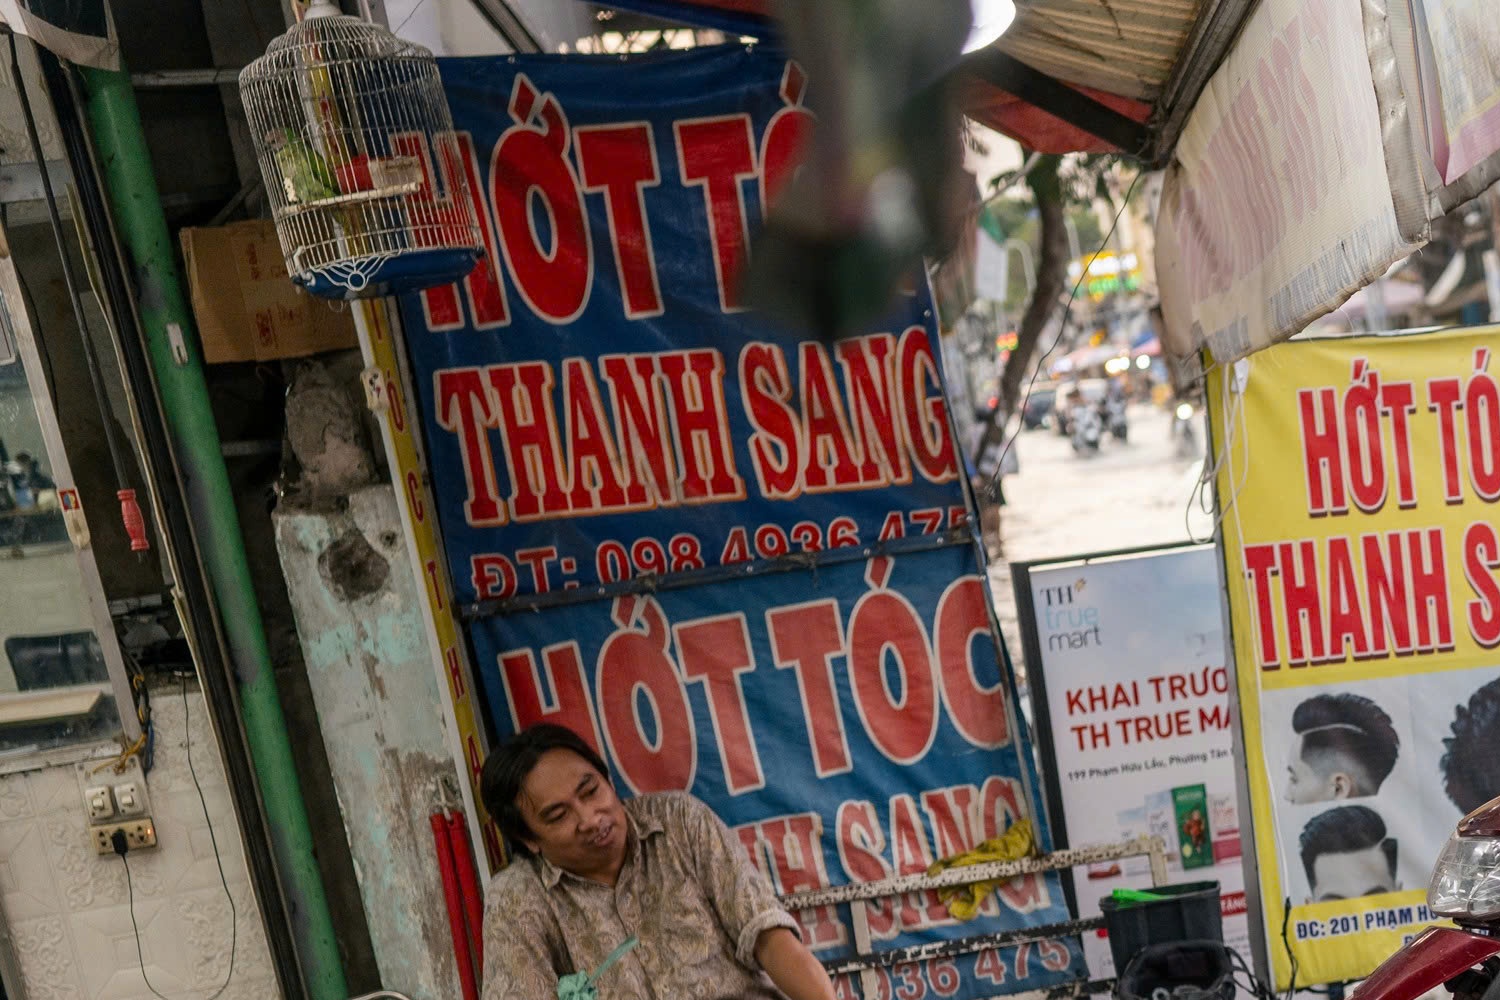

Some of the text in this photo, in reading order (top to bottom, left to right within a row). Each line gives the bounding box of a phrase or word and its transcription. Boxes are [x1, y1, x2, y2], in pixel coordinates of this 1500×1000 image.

[432, 325, 960, 527] THANH SANG
[1297, 355, 1418, 518] HỚT
[1040, 583, 1074, 606] TH
[1243, 526, 1456, 673] THANH
[1045, 606, 1099, 630] true
[1048, 626, 1103, 652] mart
[499, 554, 1011, 797] HỚT TÓC
[1065, 681, 1140, 717] KHAI
[1070, 722, 1111, 752] TH
[1115, 709, 1193, 745] TRUE
[1329, 915, 1359, 936] 201
[1364, 907, 1414, 931] PHẠM
